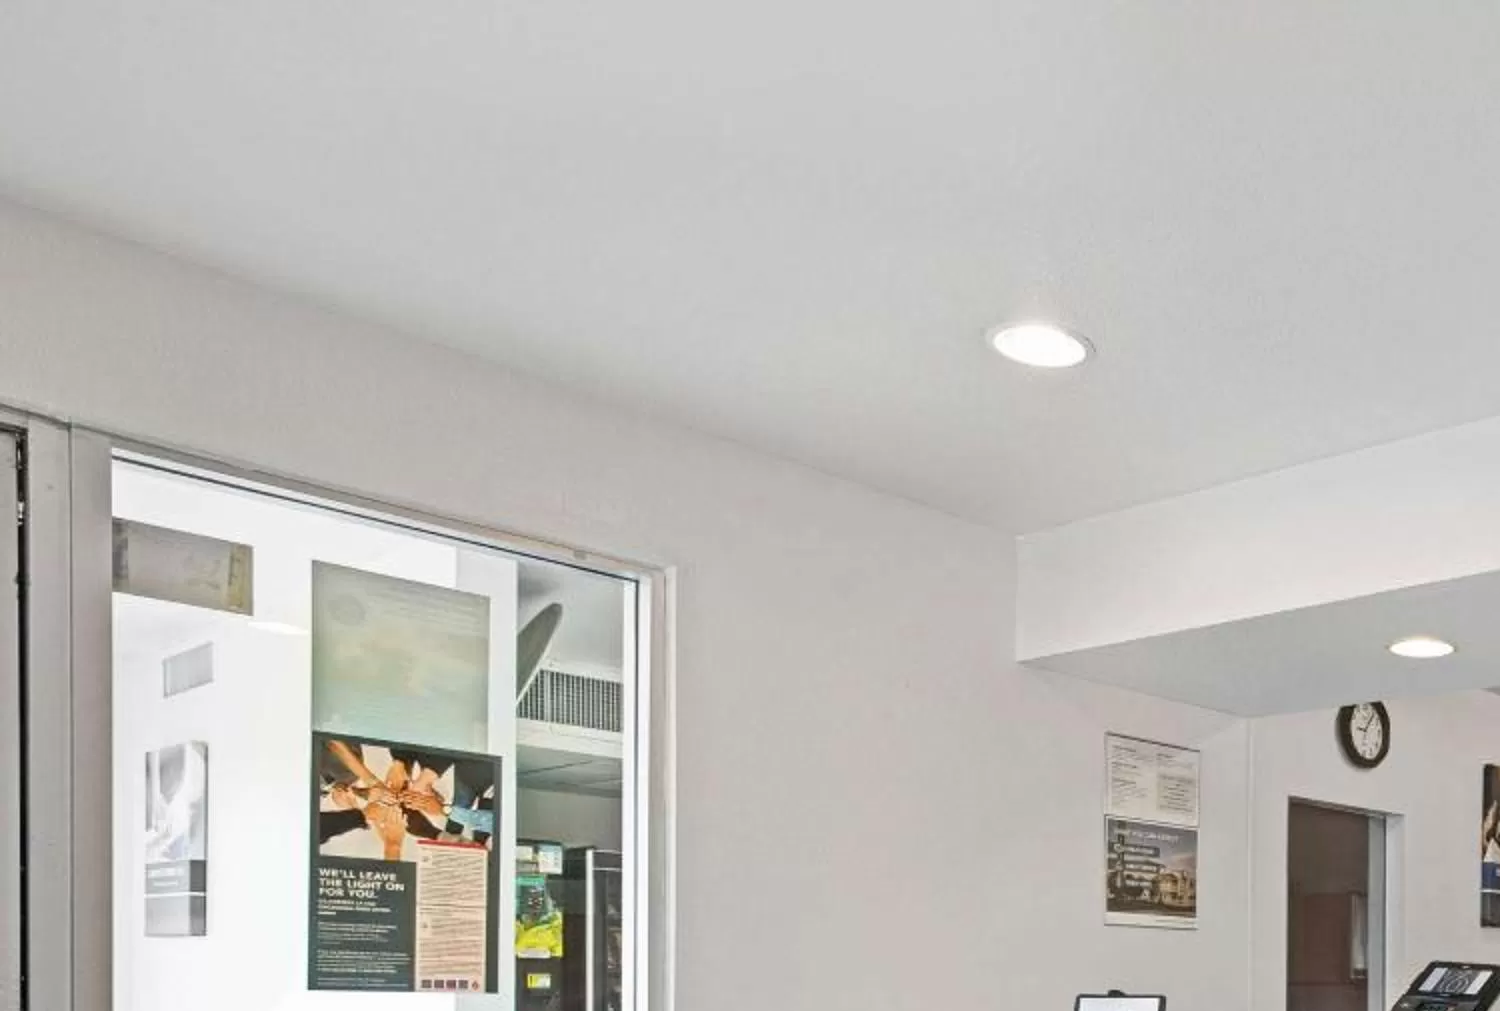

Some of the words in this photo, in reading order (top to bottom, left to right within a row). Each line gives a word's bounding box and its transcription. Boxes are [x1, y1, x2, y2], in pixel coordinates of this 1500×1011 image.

[319, 868, 356, 879] WE'LL
[359, 871, 397, 881] LEAVE
[347, 879, 382, 890] LIGHT
[385, 882, 405, 891] ON
[319, 887, 344, 897] FOR
